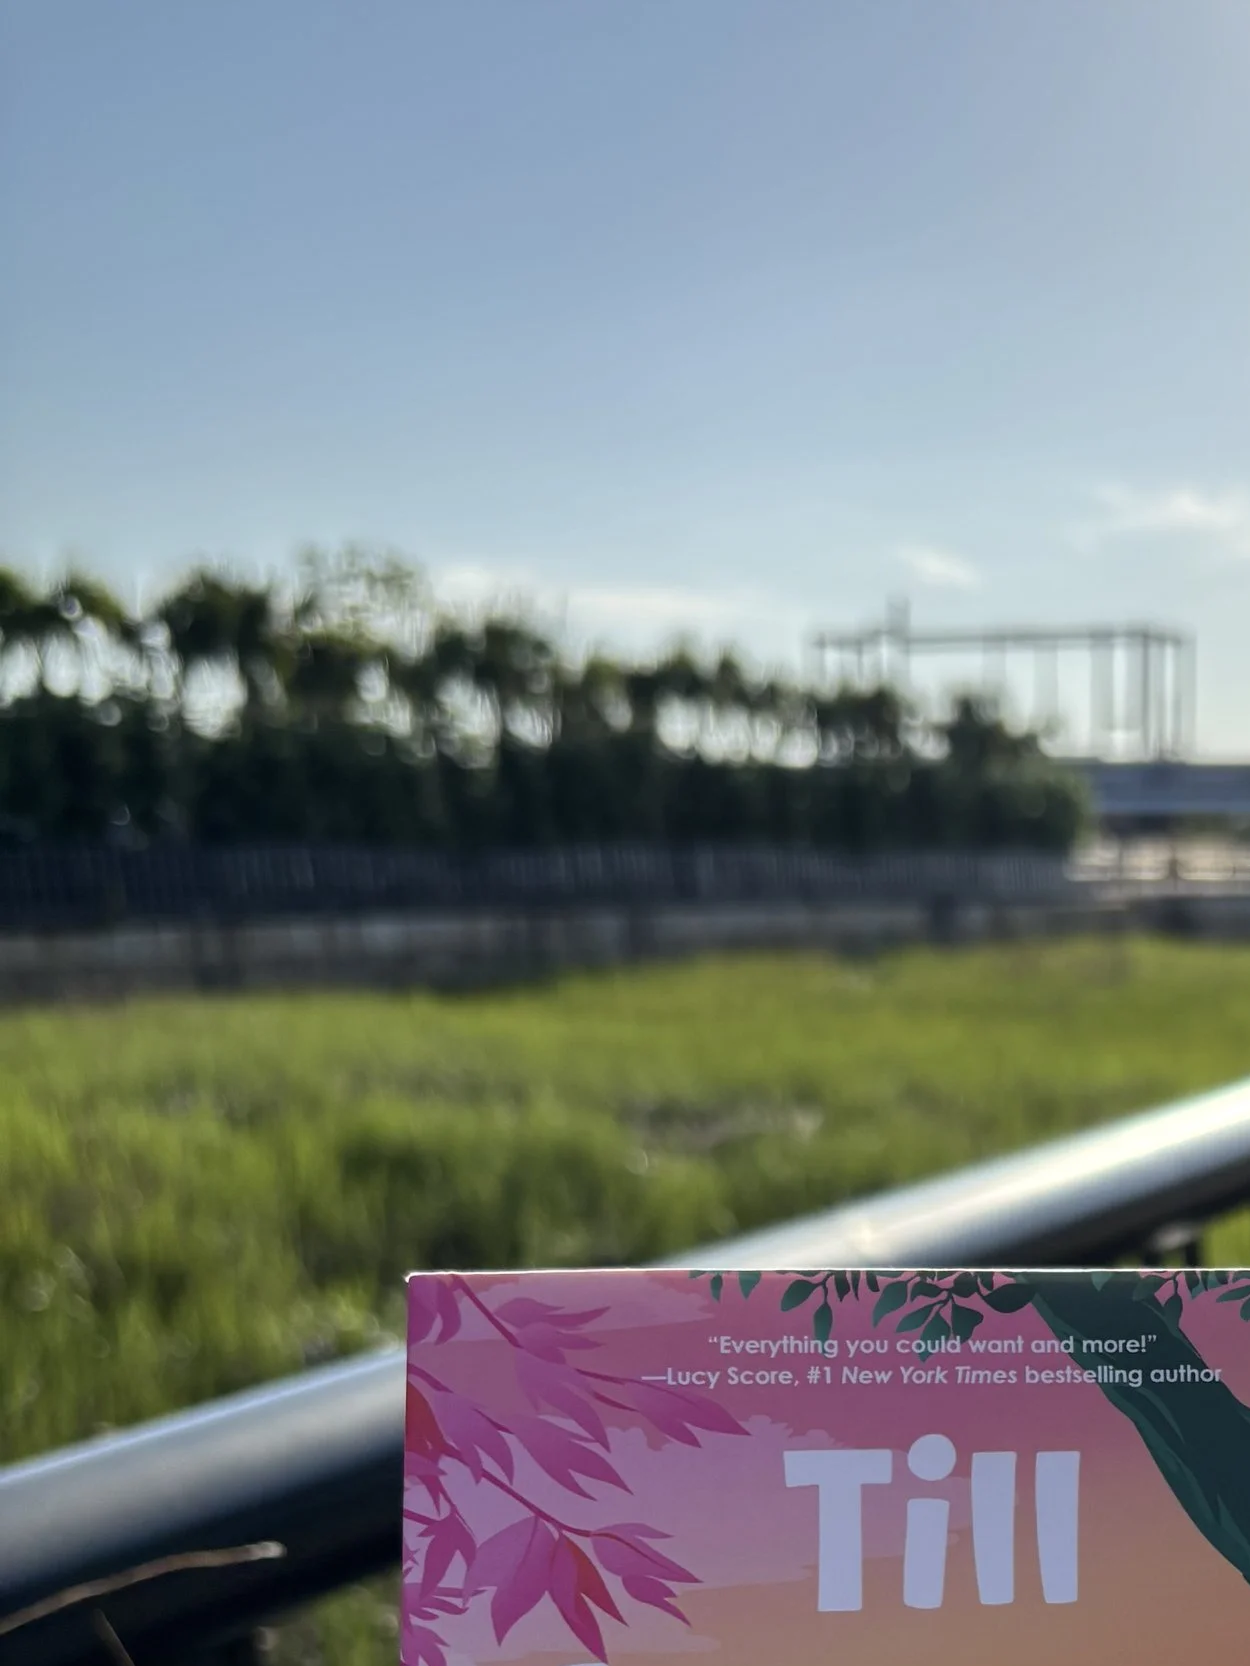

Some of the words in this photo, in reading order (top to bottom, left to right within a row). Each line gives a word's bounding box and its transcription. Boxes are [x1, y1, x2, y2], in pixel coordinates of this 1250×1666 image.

[708, 1335, 838, 1358] “Everything
[846, 1340, 888, 1358] you
[896, 1335, 961, 1353] could
[968, 1336, 1024, 1353] want
[1031, 1335, 1074, 1353] and
[1082, 1334, 1157, 1353] more!”
[727, 1366, 799, 1386] Score,
[807, 1366, 832, 1384] #1
[841, 1366, 893, 1385] New
[901, 1365, 948, 1384] York
[955, 1365, 1017, 1384] Times
[1025, 1364, 1143, 1388] bestselling
[1150, 1364, 1222, 1383] author
[784, 1433, 1081, 1611] Till
